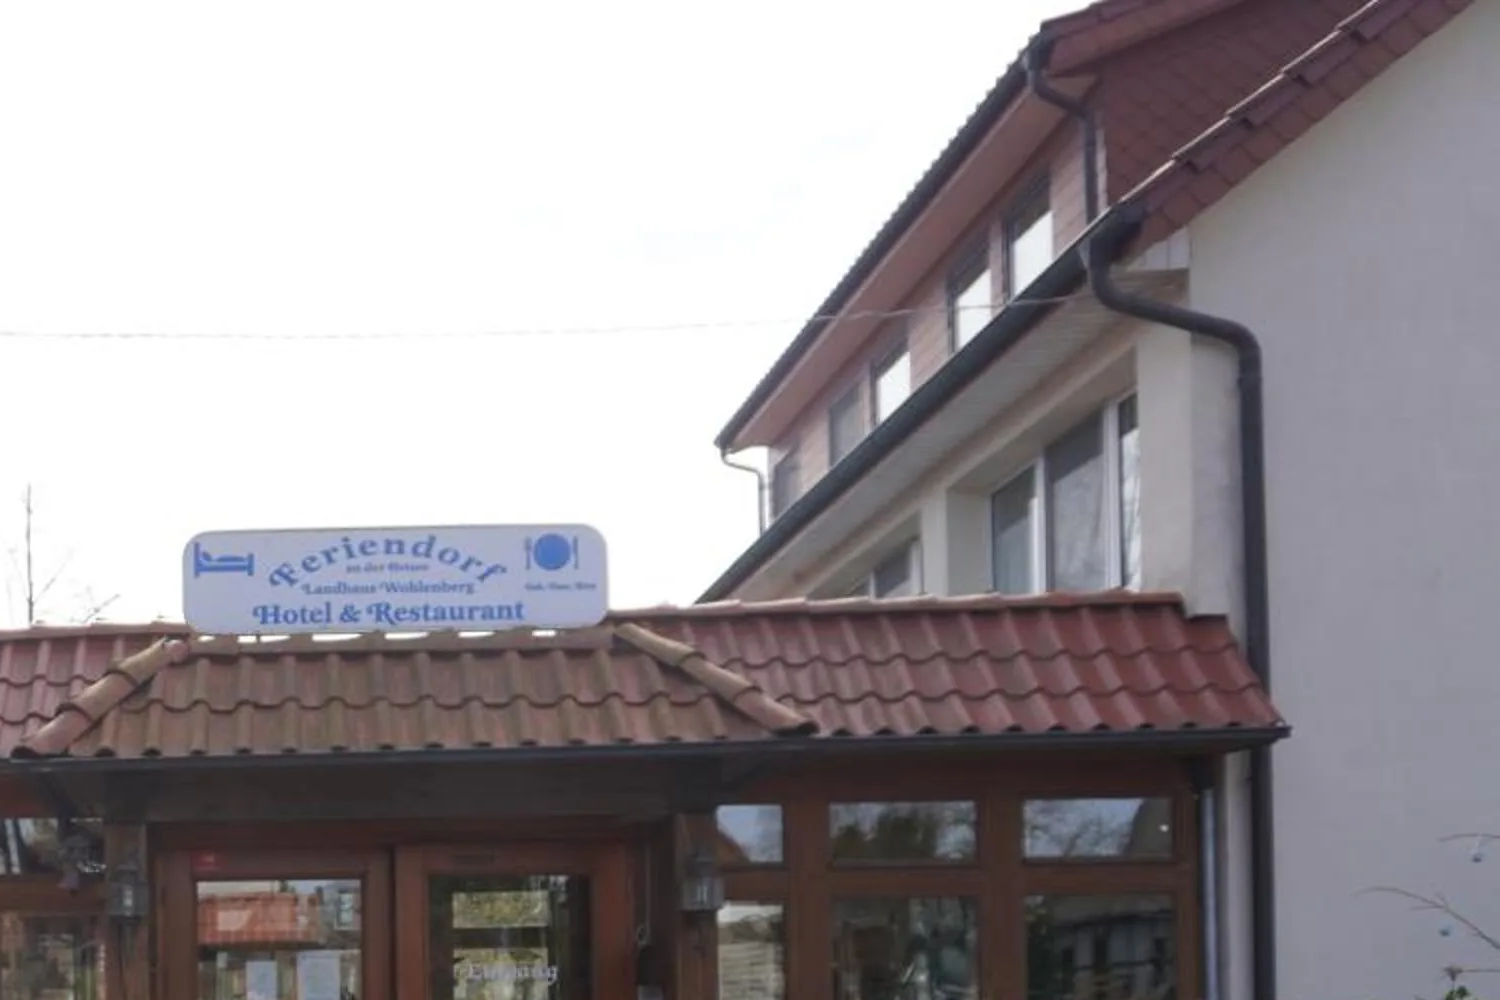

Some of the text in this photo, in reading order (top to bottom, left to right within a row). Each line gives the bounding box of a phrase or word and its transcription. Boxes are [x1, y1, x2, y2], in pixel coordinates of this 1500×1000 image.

[268, 534, 508, 588] Feriendorf
[301, 579, 476, 596] Landhaus Wohlenberg
[252, 601, 524, 627] Hotel & Restaurant
